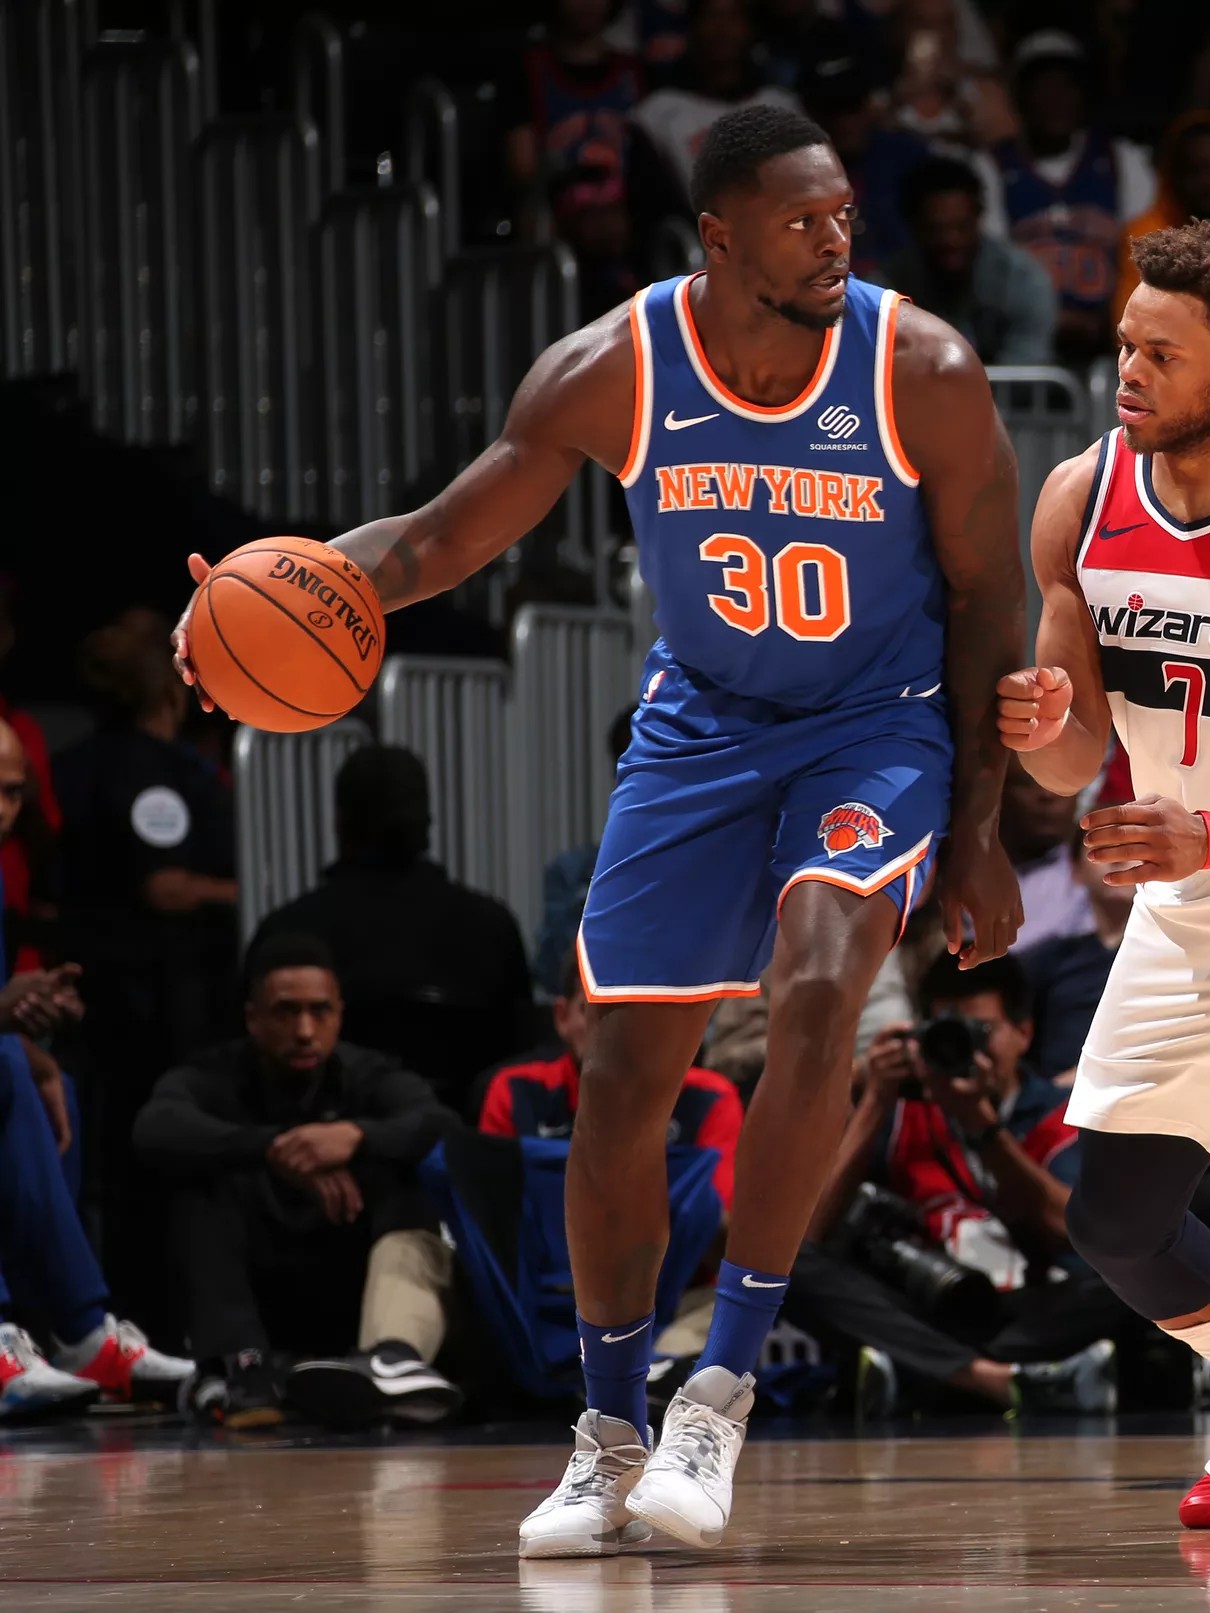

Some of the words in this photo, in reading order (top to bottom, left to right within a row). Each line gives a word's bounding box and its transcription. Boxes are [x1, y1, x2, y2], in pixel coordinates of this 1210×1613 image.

[655, 462, 757, 514] NEW
[758, 464, 885, 522] YORK
[809, 442, 868, 451] SQUARESPACE
[268, 556, 377, 661] SPALDING
[699, 533, 852, 642] 30
[1161, 660, 1206, 769] 7
